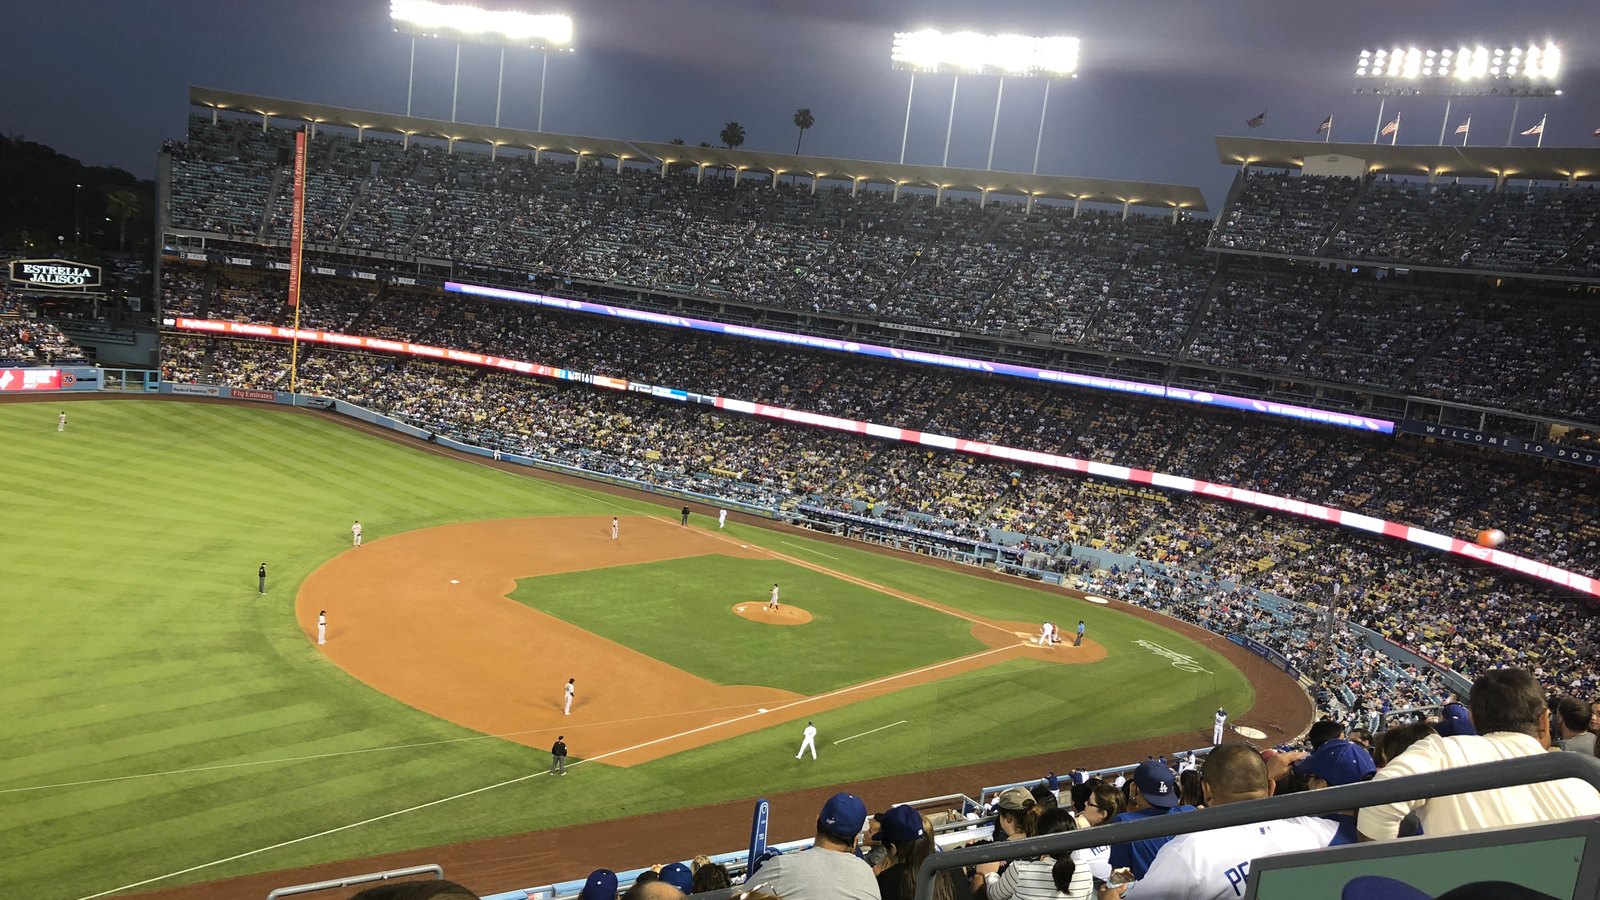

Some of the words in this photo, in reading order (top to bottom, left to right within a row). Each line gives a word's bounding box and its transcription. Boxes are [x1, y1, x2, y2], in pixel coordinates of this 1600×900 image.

[23, 264, 91, 277] ESTRELLA
[30, 274, 84, 284] JALISCO
[250, 391, 273, 400] Emirates
[1426, 426, 1508, 447] WELCOME
[1524, 443, 1543, 452] TO
[1558, 450, 1600, 462] DOD
[1158, 781, 1168, 793] LA
